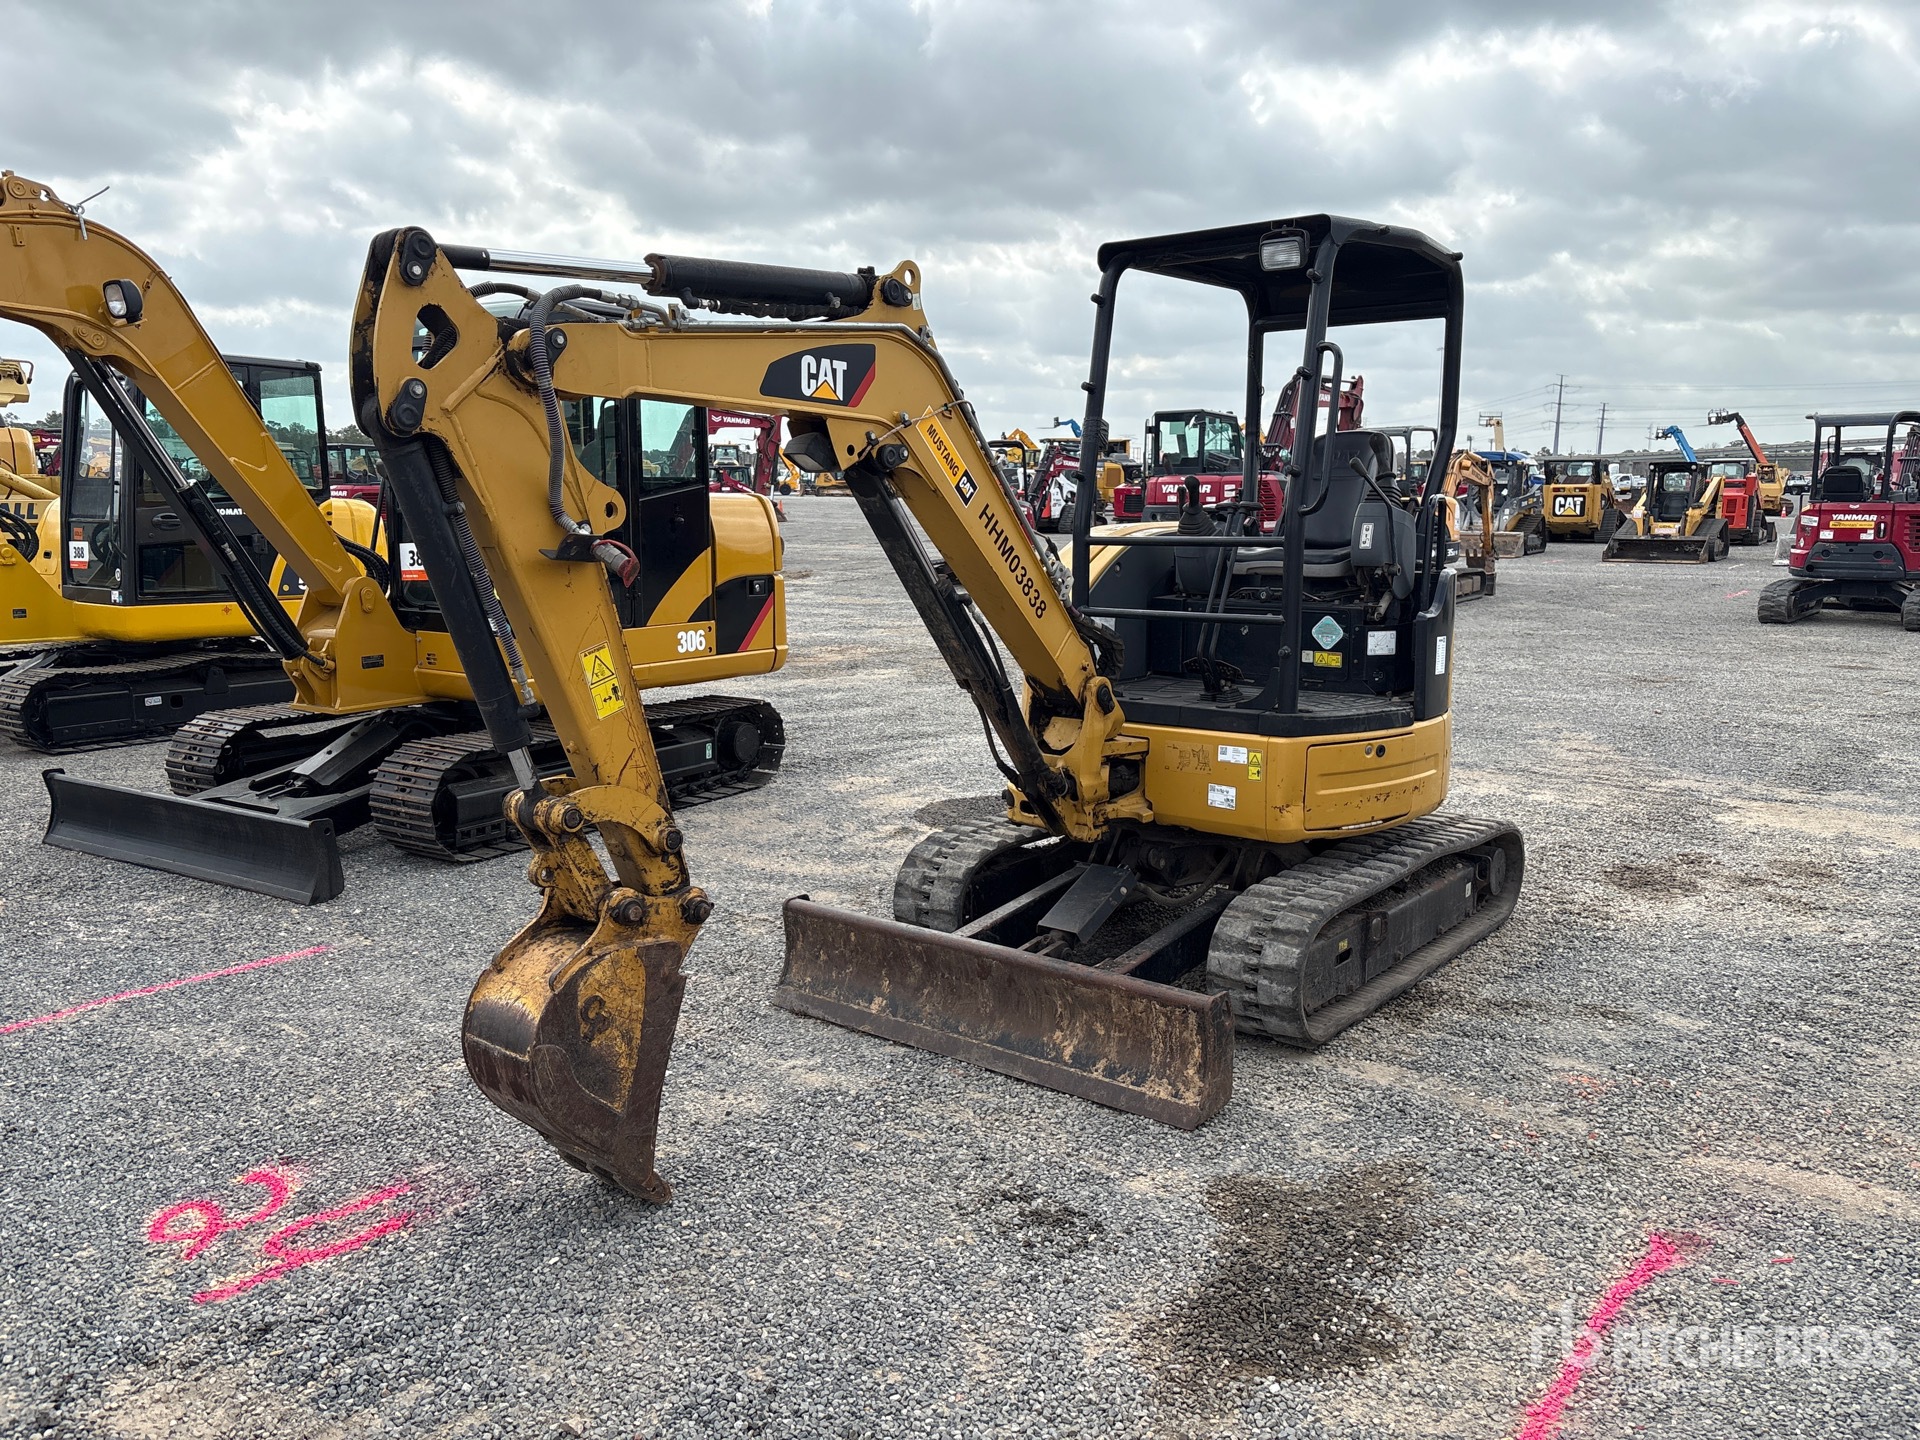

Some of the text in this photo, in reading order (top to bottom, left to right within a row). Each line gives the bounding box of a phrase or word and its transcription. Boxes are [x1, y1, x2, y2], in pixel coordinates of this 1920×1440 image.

[801, 354, 847, 401] CAT
[723, 416, 750, 425] YANMAR
[926, 423, 974, 499] MUSTANG CAT
[1063, 460, 1080, 468] YANMA
[1555, 497, 1583, 516] CAT
[73, 547, 85, 558] 388
[978, 503, 1047, 619] HHM03838
[677, 630, 706, 653] 306
